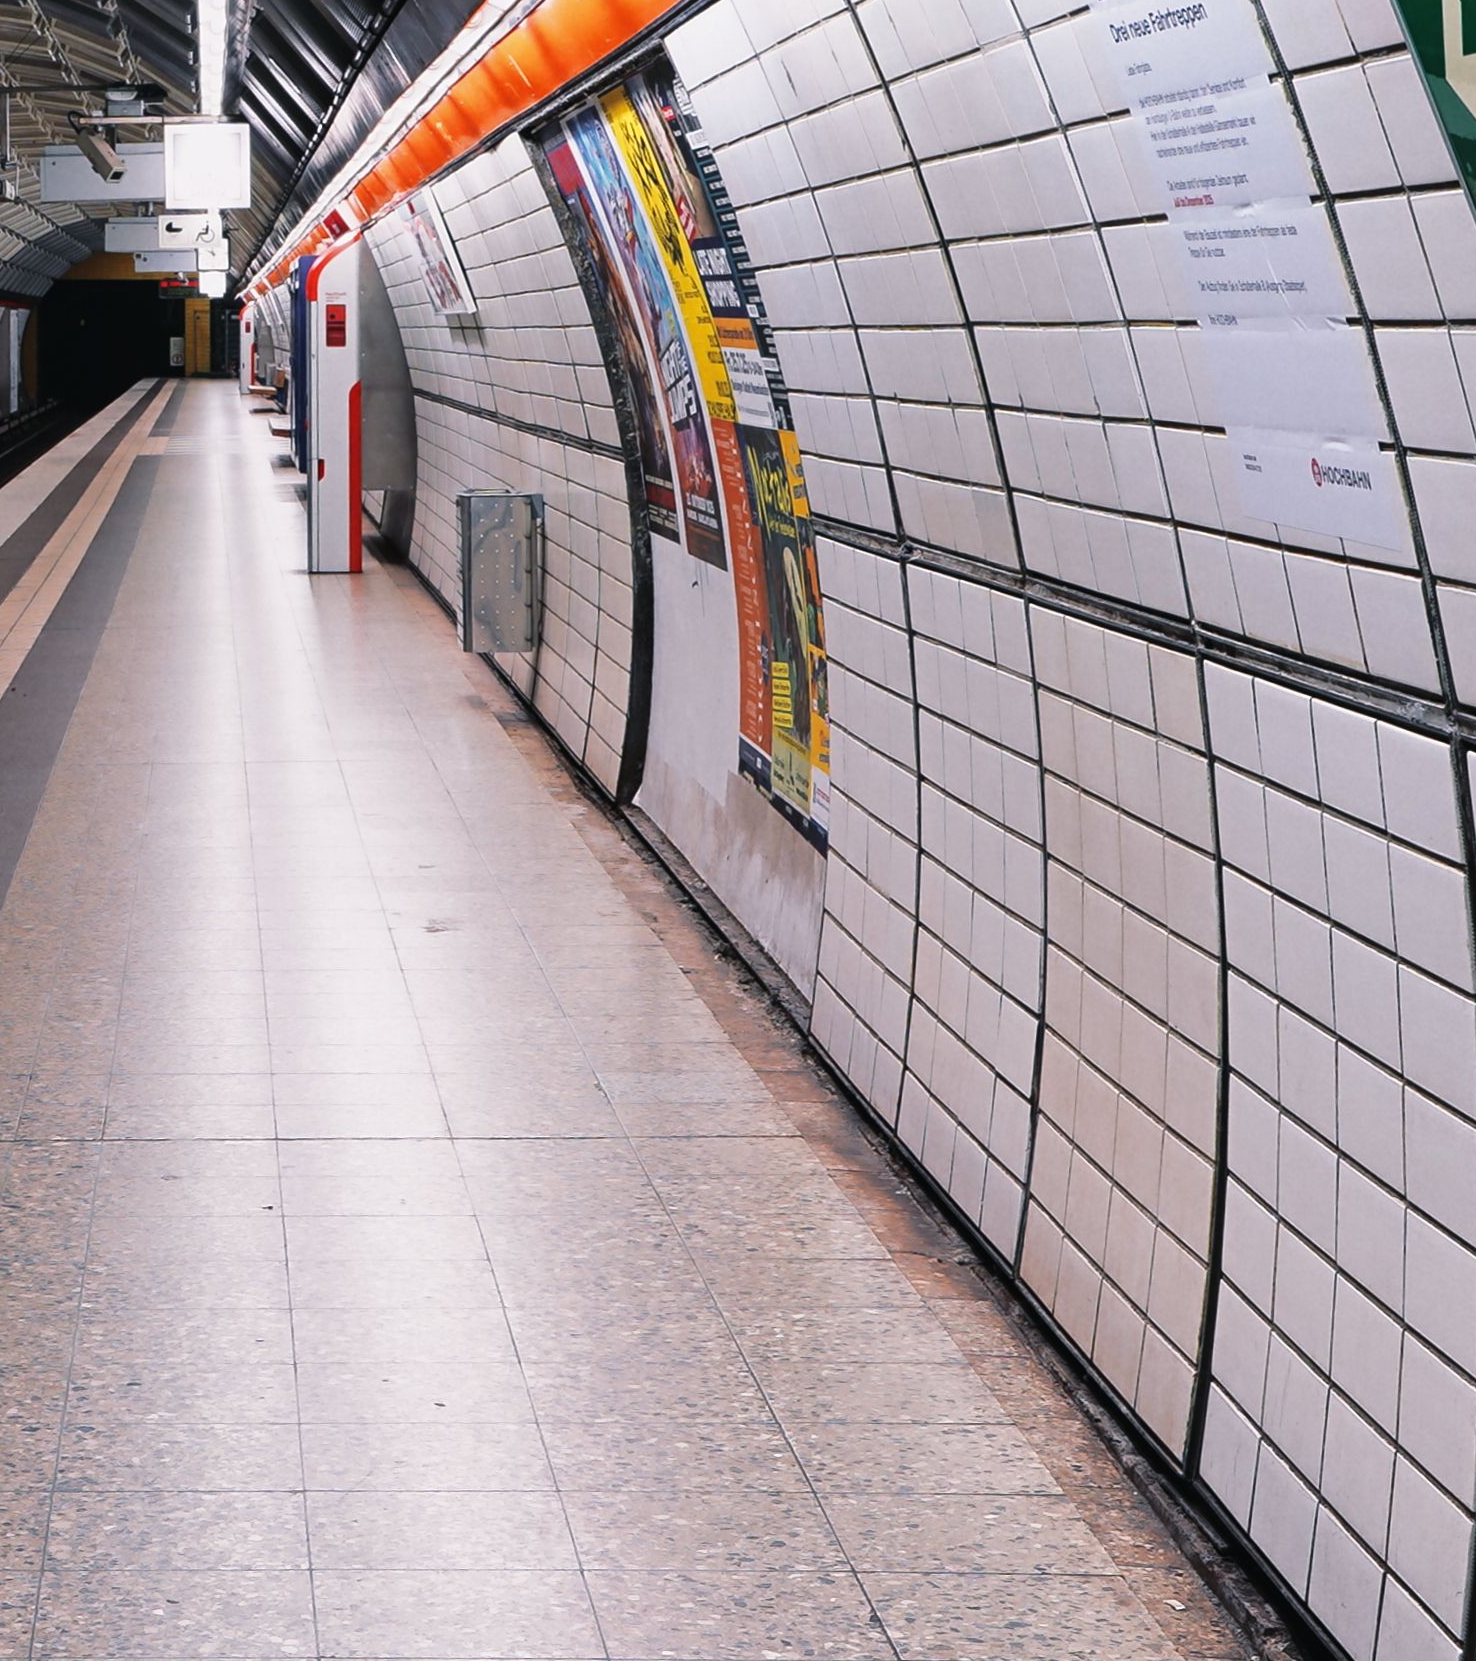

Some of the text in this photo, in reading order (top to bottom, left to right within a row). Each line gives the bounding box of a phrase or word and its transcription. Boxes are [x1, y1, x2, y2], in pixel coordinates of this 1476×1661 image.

[1109, 2, 1209, 44] Drei neue Fahrtreppen
[1321, 464, 1373, 491] HOCHBAHN
